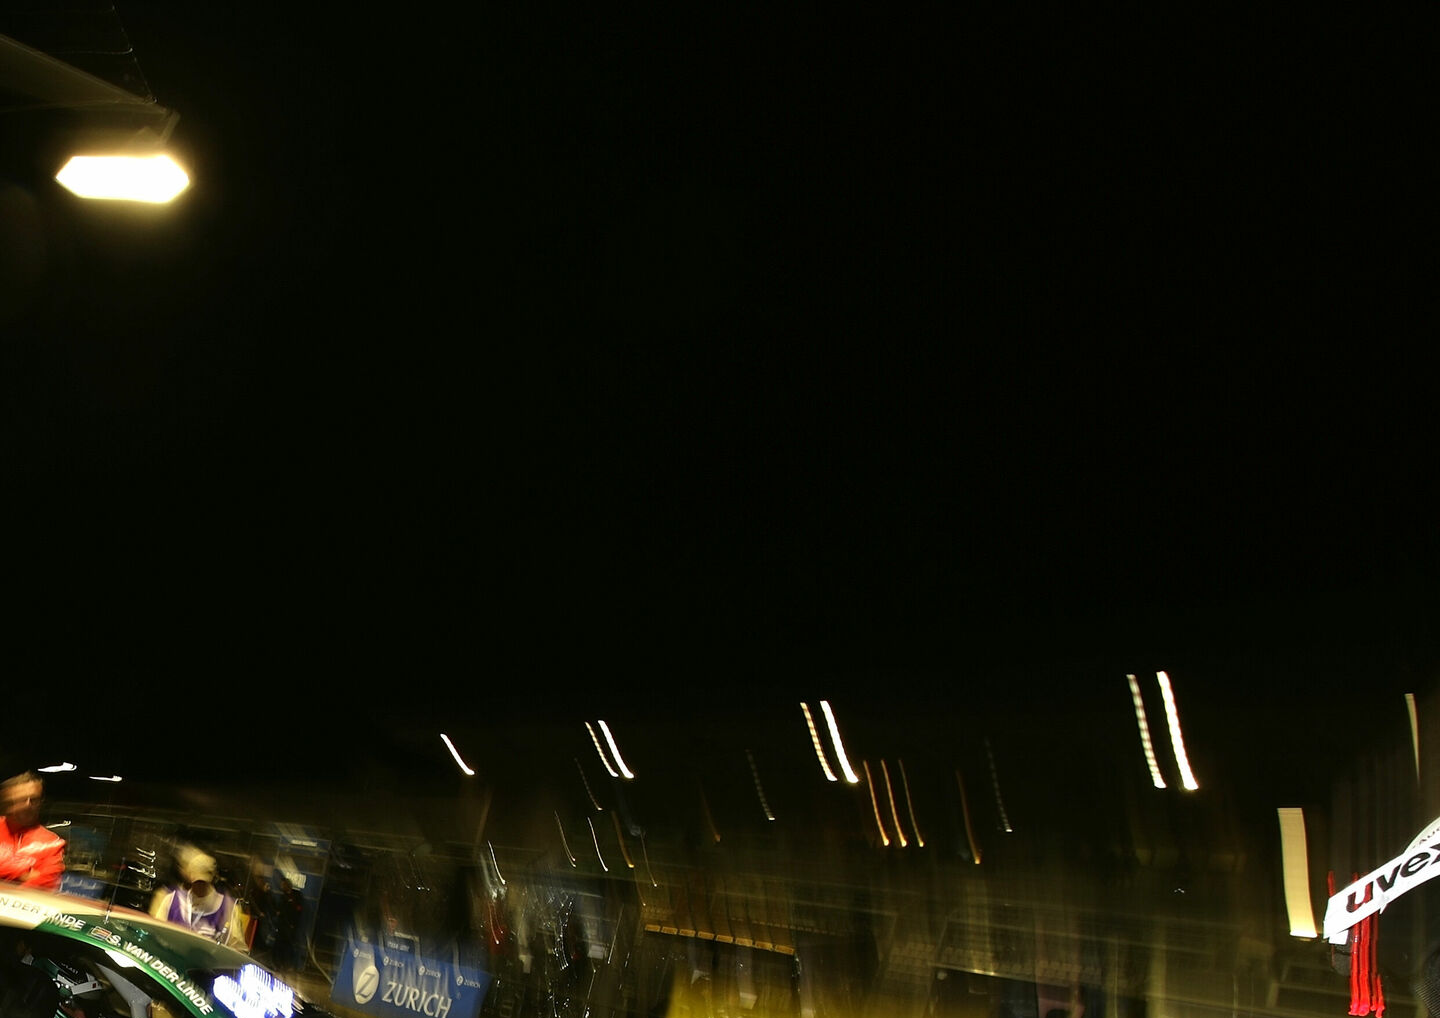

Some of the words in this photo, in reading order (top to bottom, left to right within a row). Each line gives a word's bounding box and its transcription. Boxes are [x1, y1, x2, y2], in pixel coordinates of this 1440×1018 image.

[124, 941, 154, 963] VAN
[151, 958, 180, 983] DER
[176, 980, 214, 1016] LINDE
